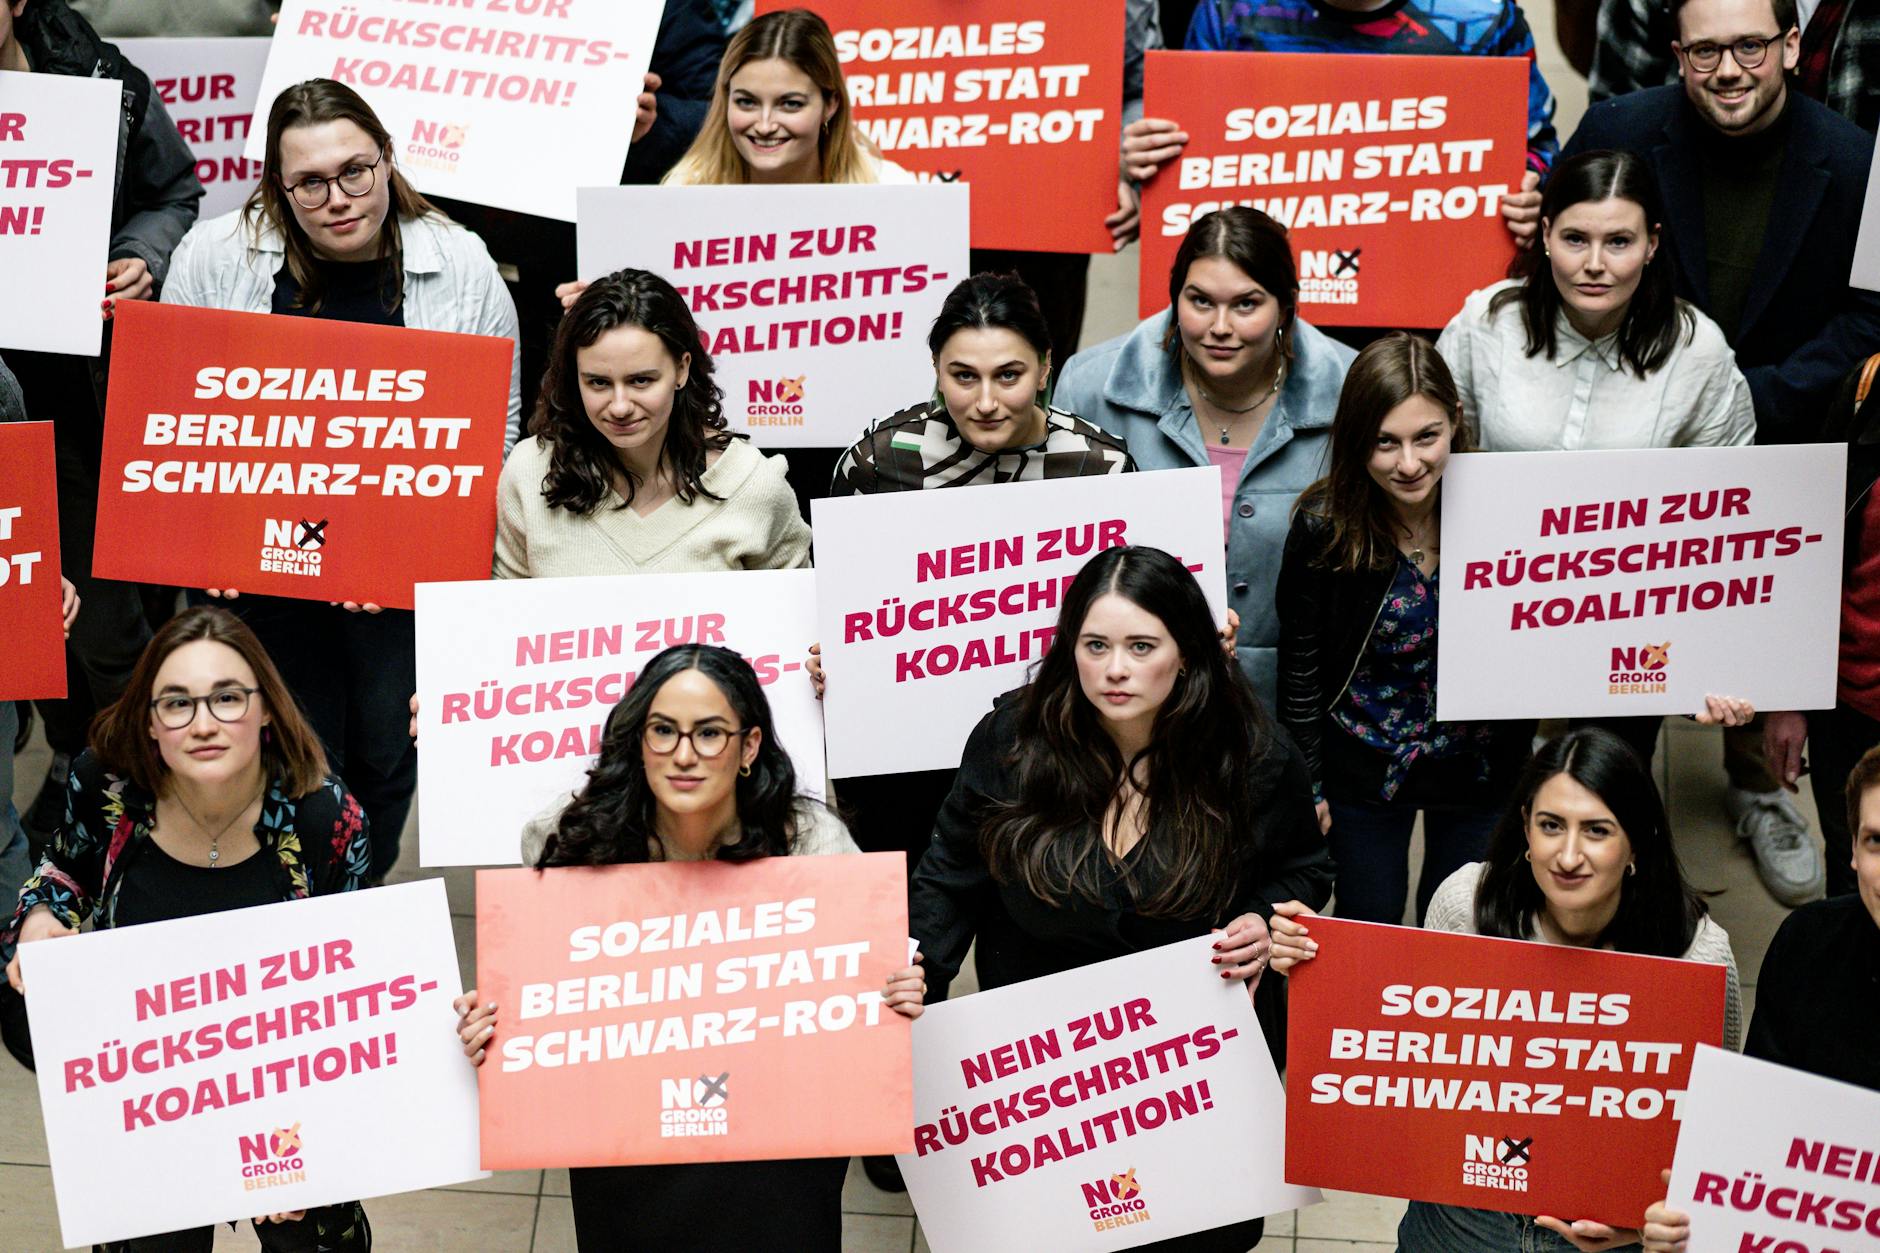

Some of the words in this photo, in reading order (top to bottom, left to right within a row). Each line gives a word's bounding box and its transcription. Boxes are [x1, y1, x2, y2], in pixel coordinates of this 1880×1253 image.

[297, 6, 631, 67] RÜCKSCHRITTS-
[833, 21, 1046, 63] SOZIALES
[155, 74, 236, 104] ZUR
[330, 56, 578, 107] KOALITION!
[846, 71, 946, 107] RLIN
[954, 64, 1090, 102] STATT
[852, 109, 1104, 151] WARZ-ROT
[1225, 96, 1448, 141] SOZIALES
[407, 143, 460, 162] GROKO
[1179, 148, 1345, 190] BERLIN
[1353, 139, 1494, 180] STATT
[674, 233, 777, 269] NEIN
[789, 224, 877, 259] ZUR
[675, 264, 949, 313] KSCHRITTS-
[1298, 279, 1359, 292] GROKO
[1298, 291, 1359, 305] BERLIN
[697, 311, 904, 356] ALITION!
[194, 367, 427, 402] SOZIALES
[143, 413, 316, 448] BERLIN
[325, 416, 472, 450] STATT
[747, 404, 803, 415] GROKO
[747, 416, 804, 426] BERLIN
[122, 460, 484, 497] SCHWARZ-ROT
[1540, 498, 1650, 537] NEIN
[1659, 487, 1752, 525] ZUR
[260, 558, 322, 577] BERLIN
[261, 546, 322, 564] GROKO
[916, 536, 1024, 583] NEIN
[1036, 519, 1128, 562] ZUR
[1463, 526, 1824, 591] RÜCKSCHRITTS-
[1510, 574, 1775, 631] KOALITION!
[515, 624, 623, 667] NEIN
[634, 613, 726, 652] ZUR
[895, 625, 1058, 683] KOALIT
[1608, 671, 1667, 683] GROKO
[1608, 683, 1667, 695] BERLIN
[569, 897, 816, 963] SOZIALES
[134, 964, 248, 1022] NEIN
[259, 938, 356, 991] ZUR
[519, 963, 704, 1020] BERLIN
[716, 941, 871, 995] STATT
[1381, 984, 1632, 1026] SOZIALES
[63, 974, 438, 1094] RÜCKSCHRITTS-
[502, 990, 889, 1073] SCHWARZ-ROT
[960, 1028, 1063, 1090] NEIN
[1067, 997, 1158, 1053] ZUR
[1329, 1028, 1512, 1068] BERLIN
[1524, 1036, 1683, 1075] STATT
[122, 1032, 398, 1132] KOALITION!
[913, 1024, 1239, 1158] RÜCKSCHRITTS-
[1310, 1073, 1688, 1121] SCHWARZ-ROT
[660, 1107, 728, 1124] GROKO
[660, 1121, 728, 1138] BERLIN
[969, 1079, 1215, 1189] KOALITION!
[241, 1156, 305, 1179] GROKO
[243, 1170, 307, 1192] BERLIN
[1462, 1160, 1529, 1180] GROKO
[1462, 1173, 1529, 1192] BERLIN
[1785, 1137, 1880, 1186] NEI
[1089, 1198, 1146, 1221] GROKO
[1094, 1209, 1152, 1233] BERLIN
